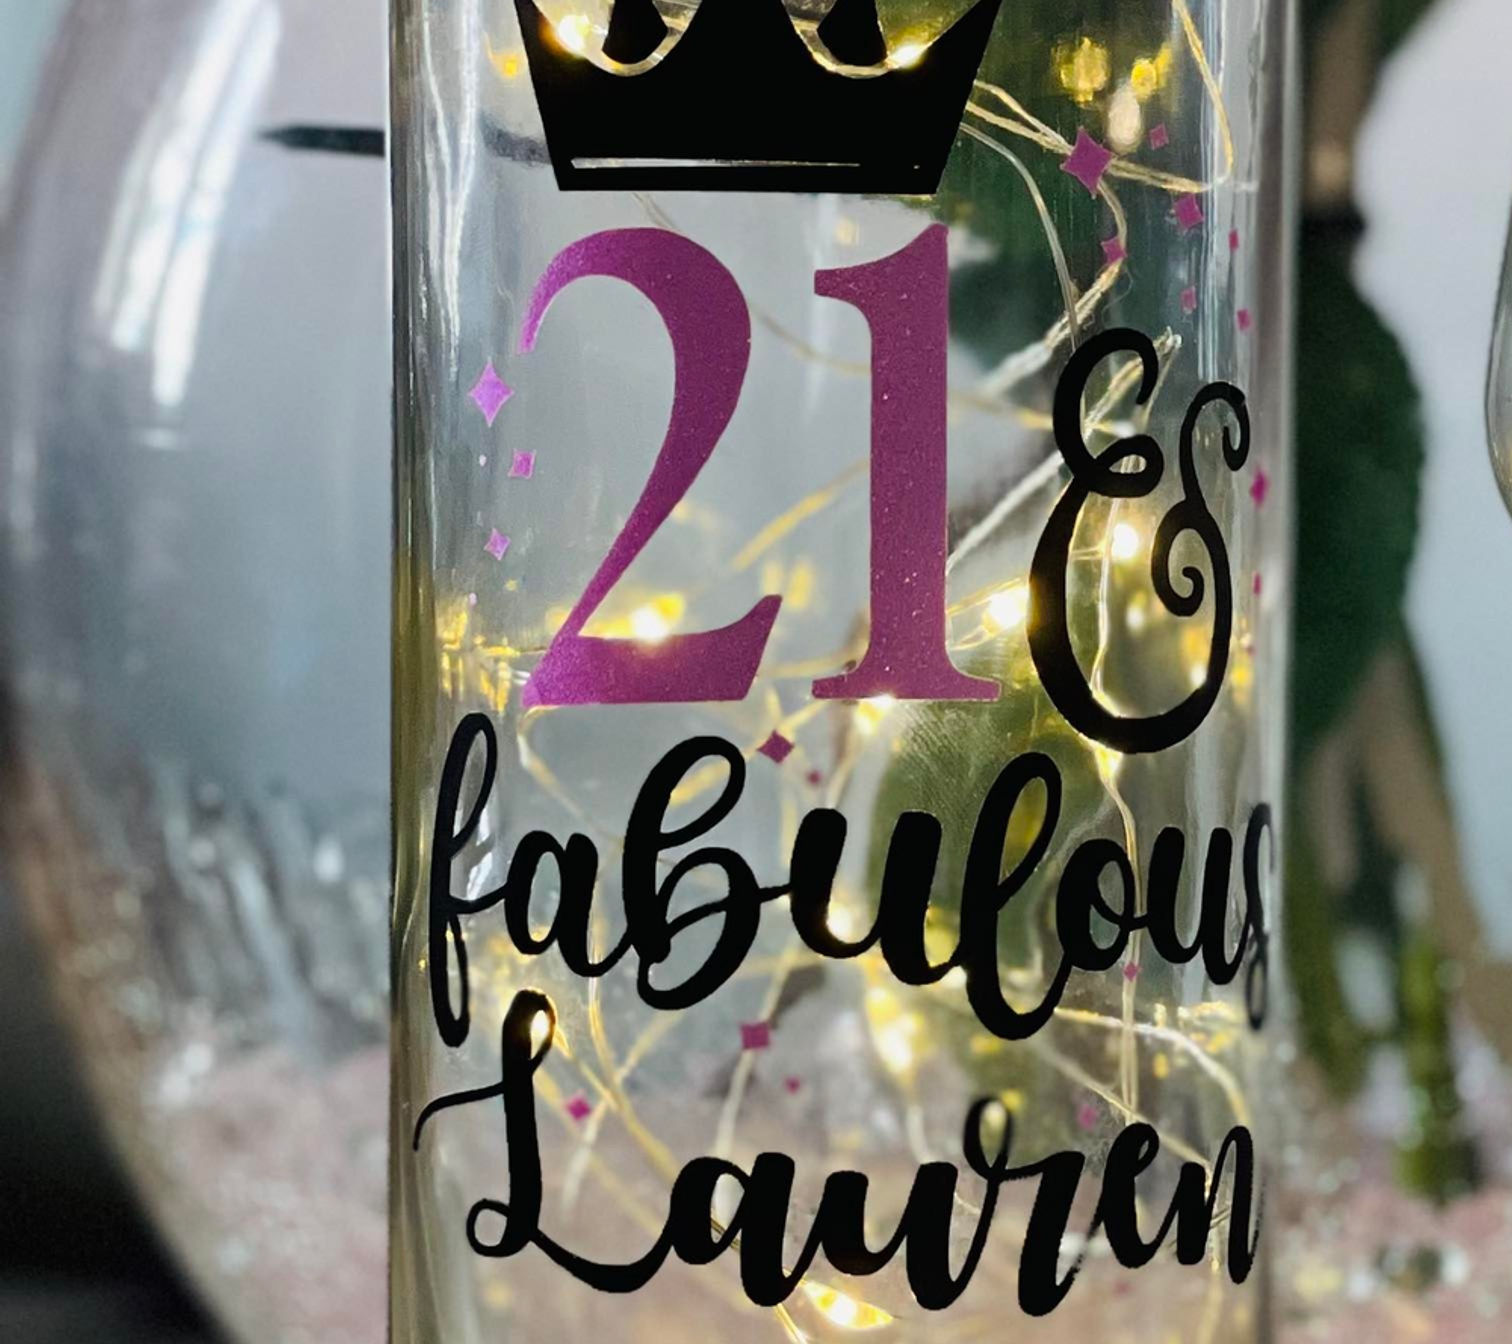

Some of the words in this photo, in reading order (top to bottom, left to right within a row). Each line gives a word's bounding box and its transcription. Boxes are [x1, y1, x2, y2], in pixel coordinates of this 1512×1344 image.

[519, 223, 999, 707] 21
[1028, 328, 1250, 753] &
[428, 712, 1273, 1047] fabulous
[413, 988, 1260, 1316] Lauren
